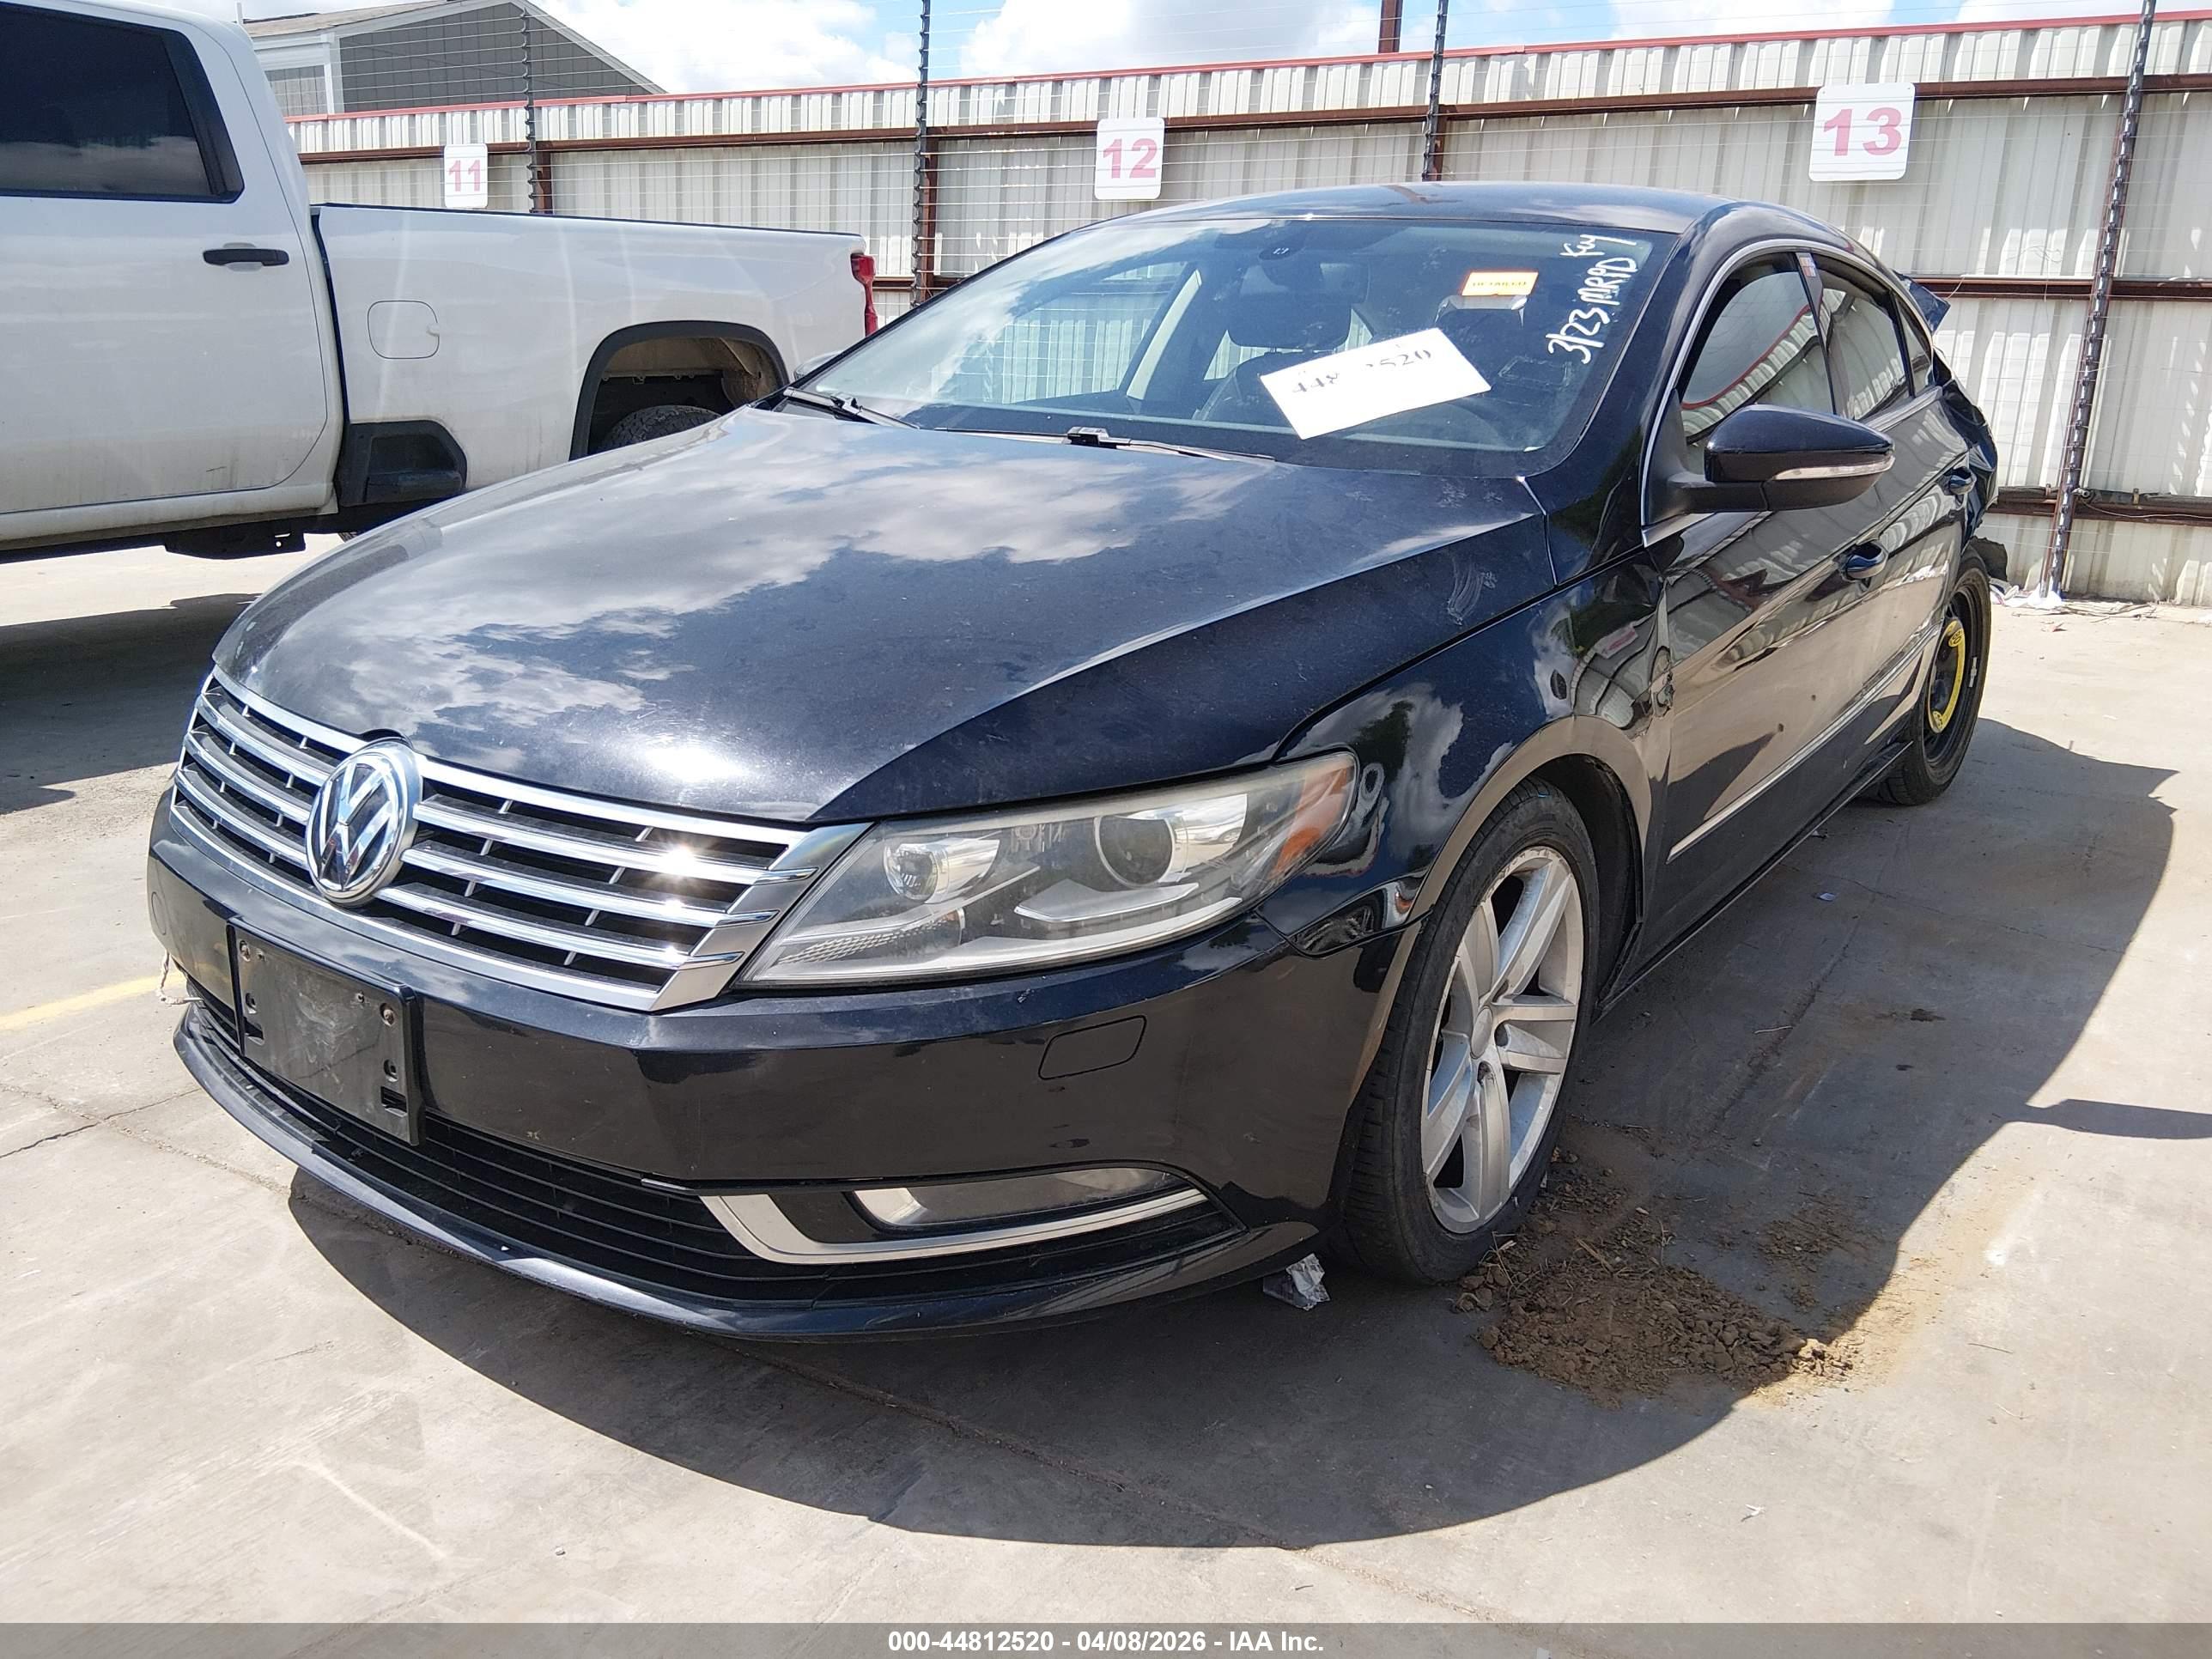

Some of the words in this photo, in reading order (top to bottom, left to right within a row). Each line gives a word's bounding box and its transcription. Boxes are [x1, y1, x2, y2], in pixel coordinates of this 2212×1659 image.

[1823, 107, 1902, 156] 13
[448, 160, 481, 191] 11
[1103, 138, 1158, 179] 12
[1546, 307, 1610, 364] 3/23
